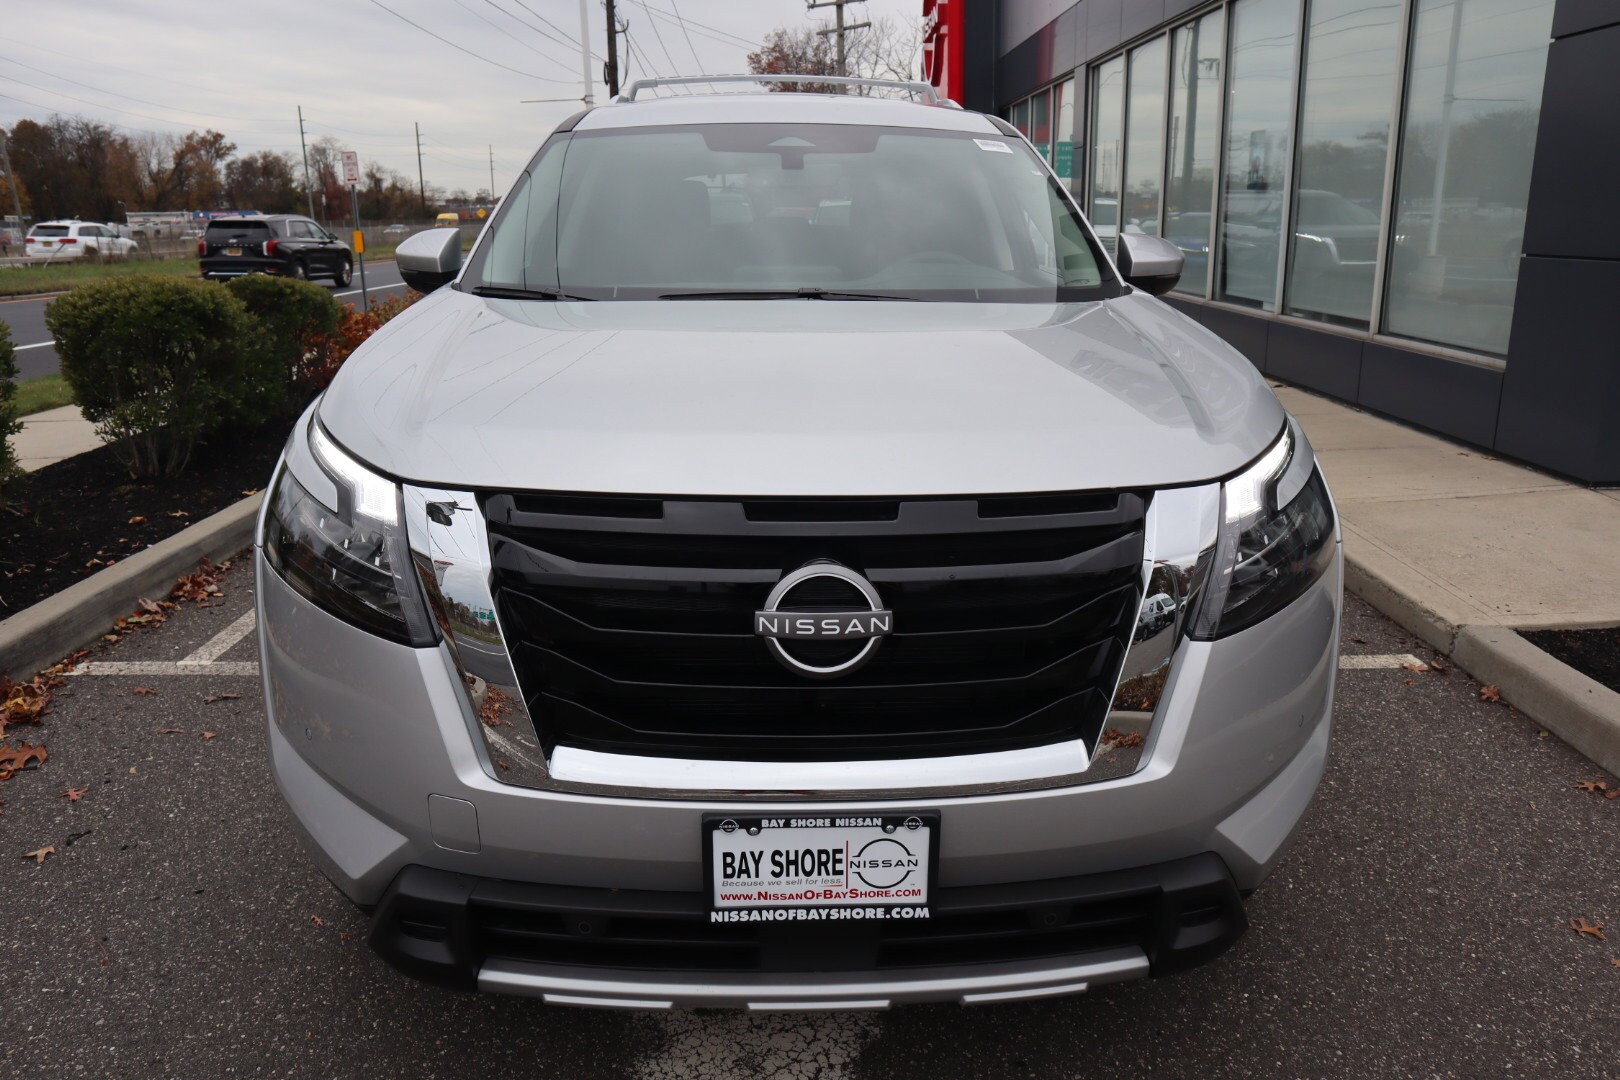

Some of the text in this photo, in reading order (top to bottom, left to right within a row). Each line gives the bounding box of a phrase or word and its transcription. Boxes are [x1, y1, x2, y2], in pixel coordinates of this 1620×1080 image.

[759, 616, 888, 634] NISSAN
[761, 818, 882, 828] BAY SHORE NISSAN
[722, 848, 844, 880] BAY SHORE
[850, 859, 918, 869] NISSAN
[785, 878, 803, 886] sell
[805, 877, 819, 885] for
[820, 877, 843, 885] less.
[710, 907, 930, 923] NISSANOFBAYSHORE.COM
